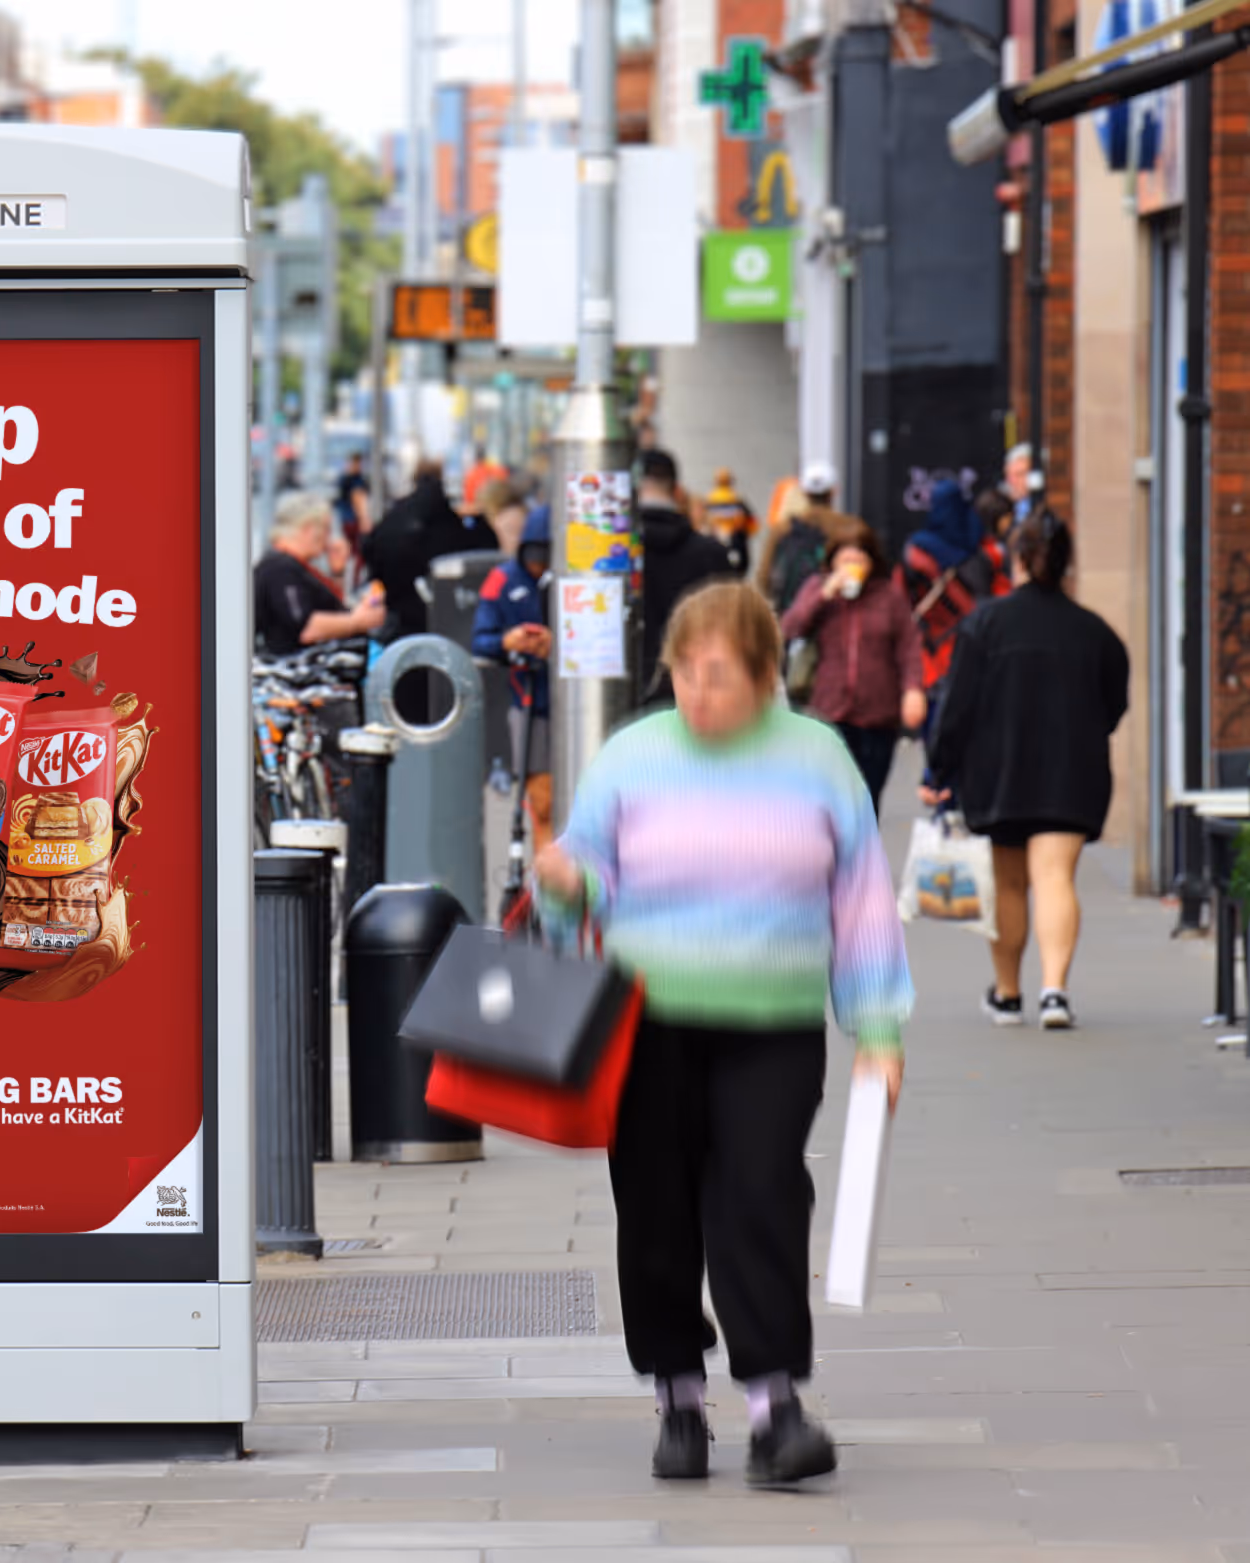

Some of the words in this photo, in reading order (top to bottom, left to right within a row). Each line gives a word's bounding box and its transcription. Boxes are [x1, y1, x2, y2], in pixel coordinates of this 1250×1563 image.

[4, 488, 85, 549] of
[26, 732, 103, 786] KitKat
[27, 853, 81, 865] CARAMEL
[34, 843, 77, 854] SALTED
[30, 1077, 123, 1104] BARS
[1, 1107, 44, 1125] have
[49, 1113, 60, 1125] a
